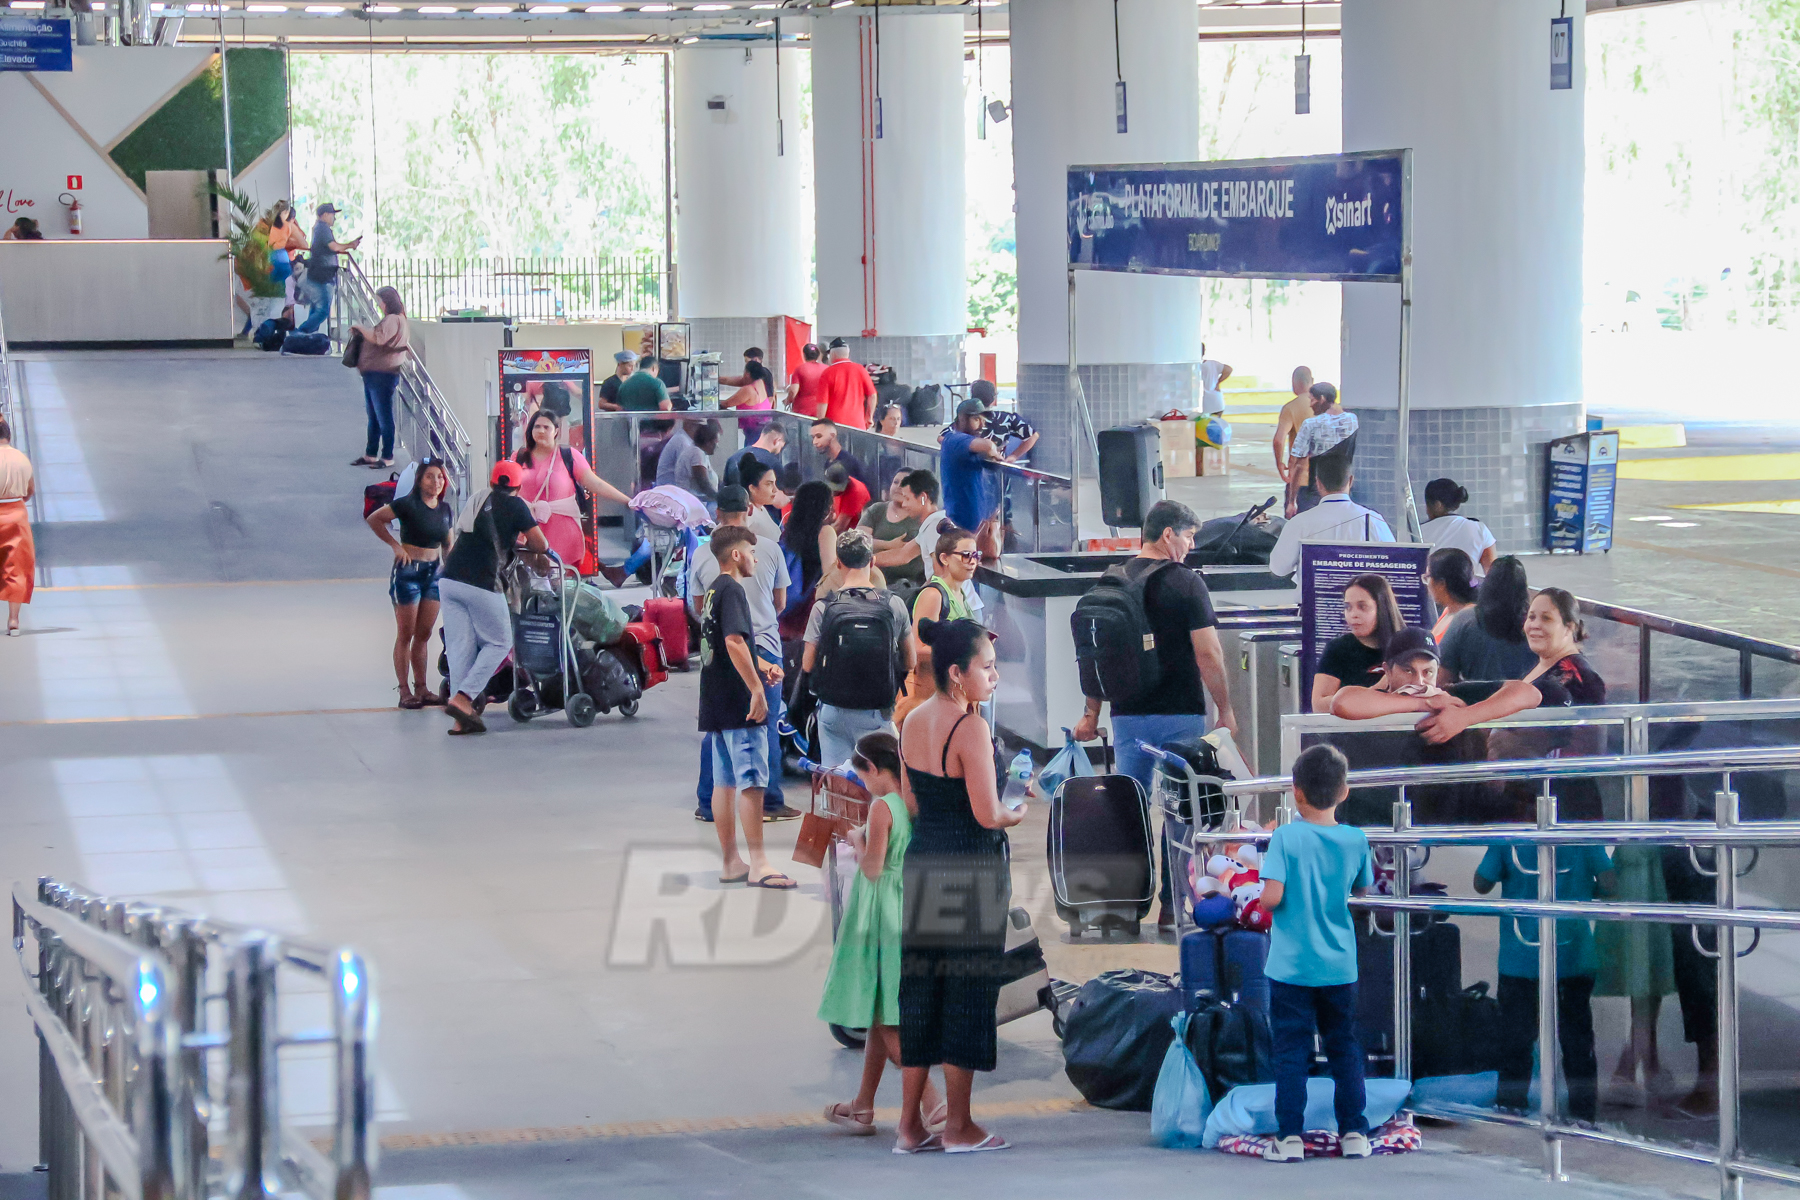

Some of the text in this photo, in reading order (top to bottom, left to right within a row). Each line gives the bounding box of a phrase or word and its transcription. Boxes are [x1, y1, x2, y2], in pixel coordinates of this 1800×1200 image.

[7, 189, 35, 214] Love
[1125, 182, 1199, 219] PLATAFORMA
[1202, 181, 1219, 218] DE
[1221, 179, 1295, 220] EMBARQUE
[1336, 192, 1372, 229] sinart
[1312, 560, 1353, 568] EMBARQUE
[1366, 562, 1417, 570] PASSAGEIROS
